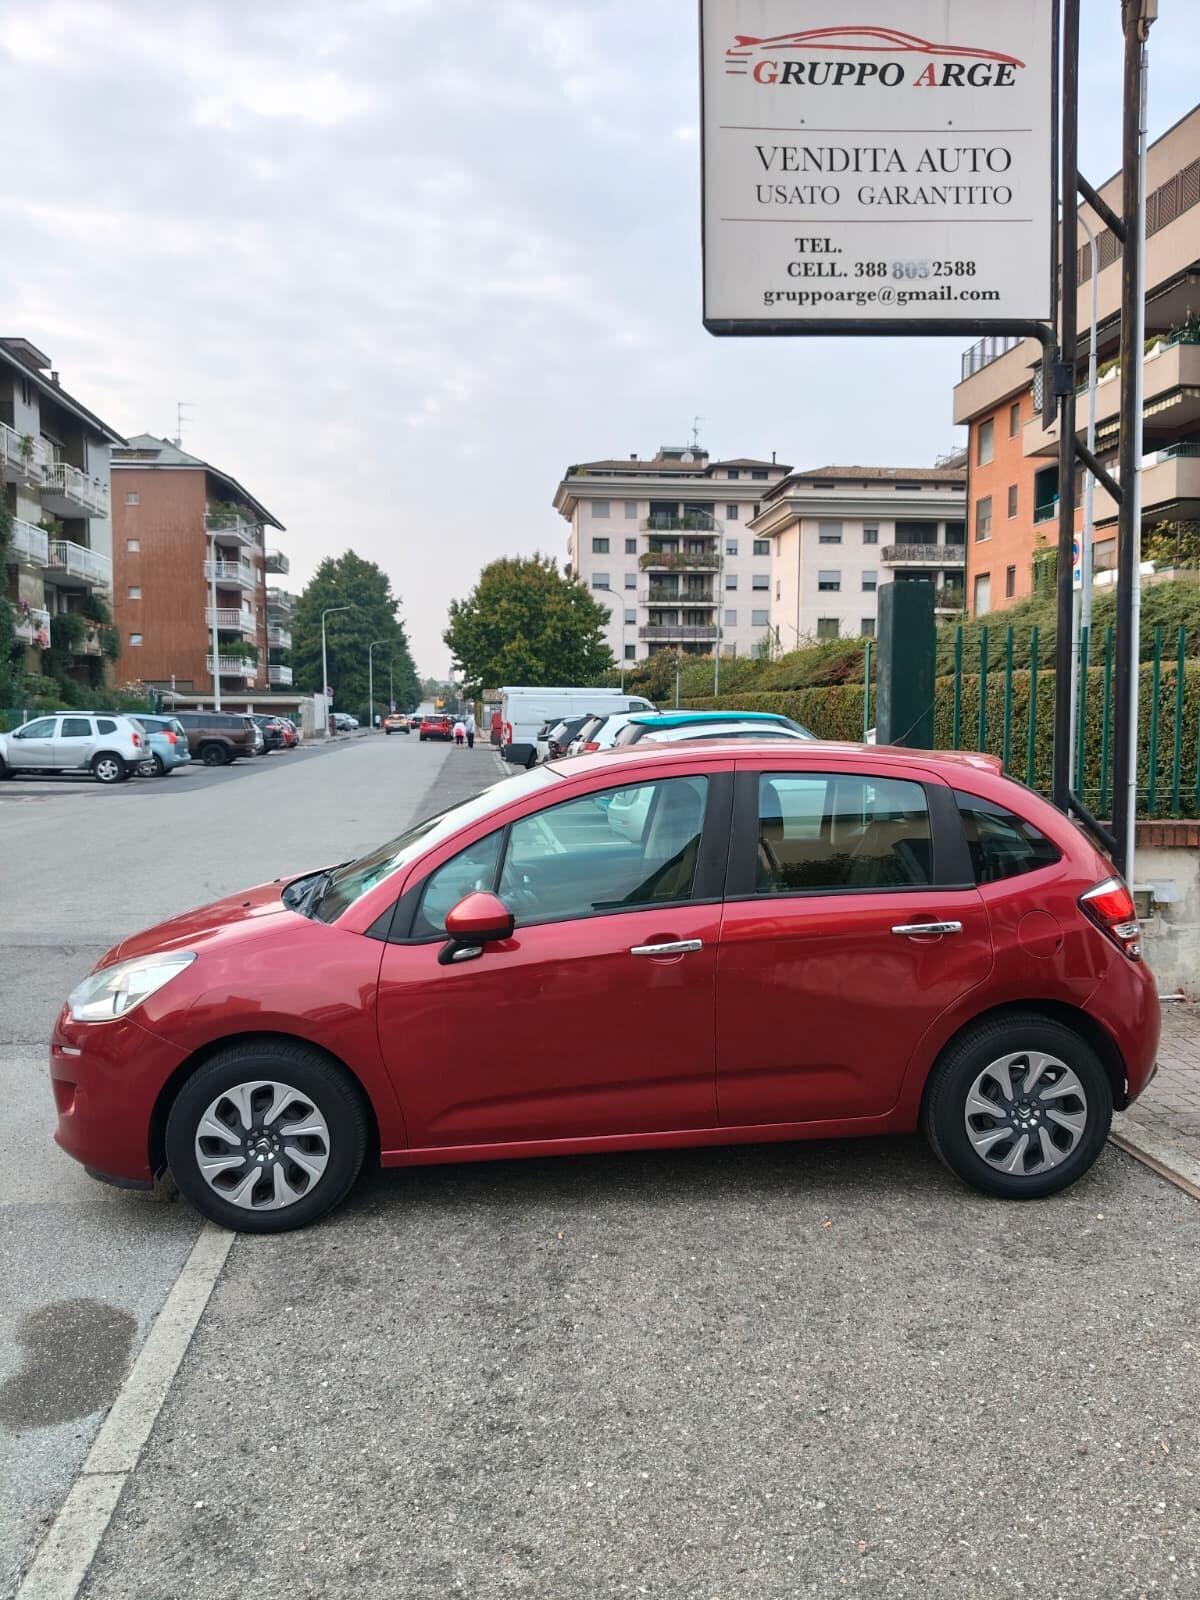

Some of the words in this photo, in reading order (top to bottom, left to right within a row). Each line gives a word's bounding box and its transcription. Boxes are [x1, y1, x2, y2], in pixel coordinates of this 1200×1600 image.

[753, 61, 905, 87] GRUPPO
[913, 62, 1017, 87] ARGE
[754, 145, 907, 173] VENDITA
[915, 147, 1012, 173] AUTO
[755, 184, 841, 205] USATO
[857, 186, 1013, 206] GARANTITO
[794, 237, 843, 254] TEL.
[786, 262, 849, 278] CELL.
[854, 262, 888, 278] 388
[932, 260, 977, 277] 2588
[763, 285, 1001, 307] gruppoarge@gmail.com
